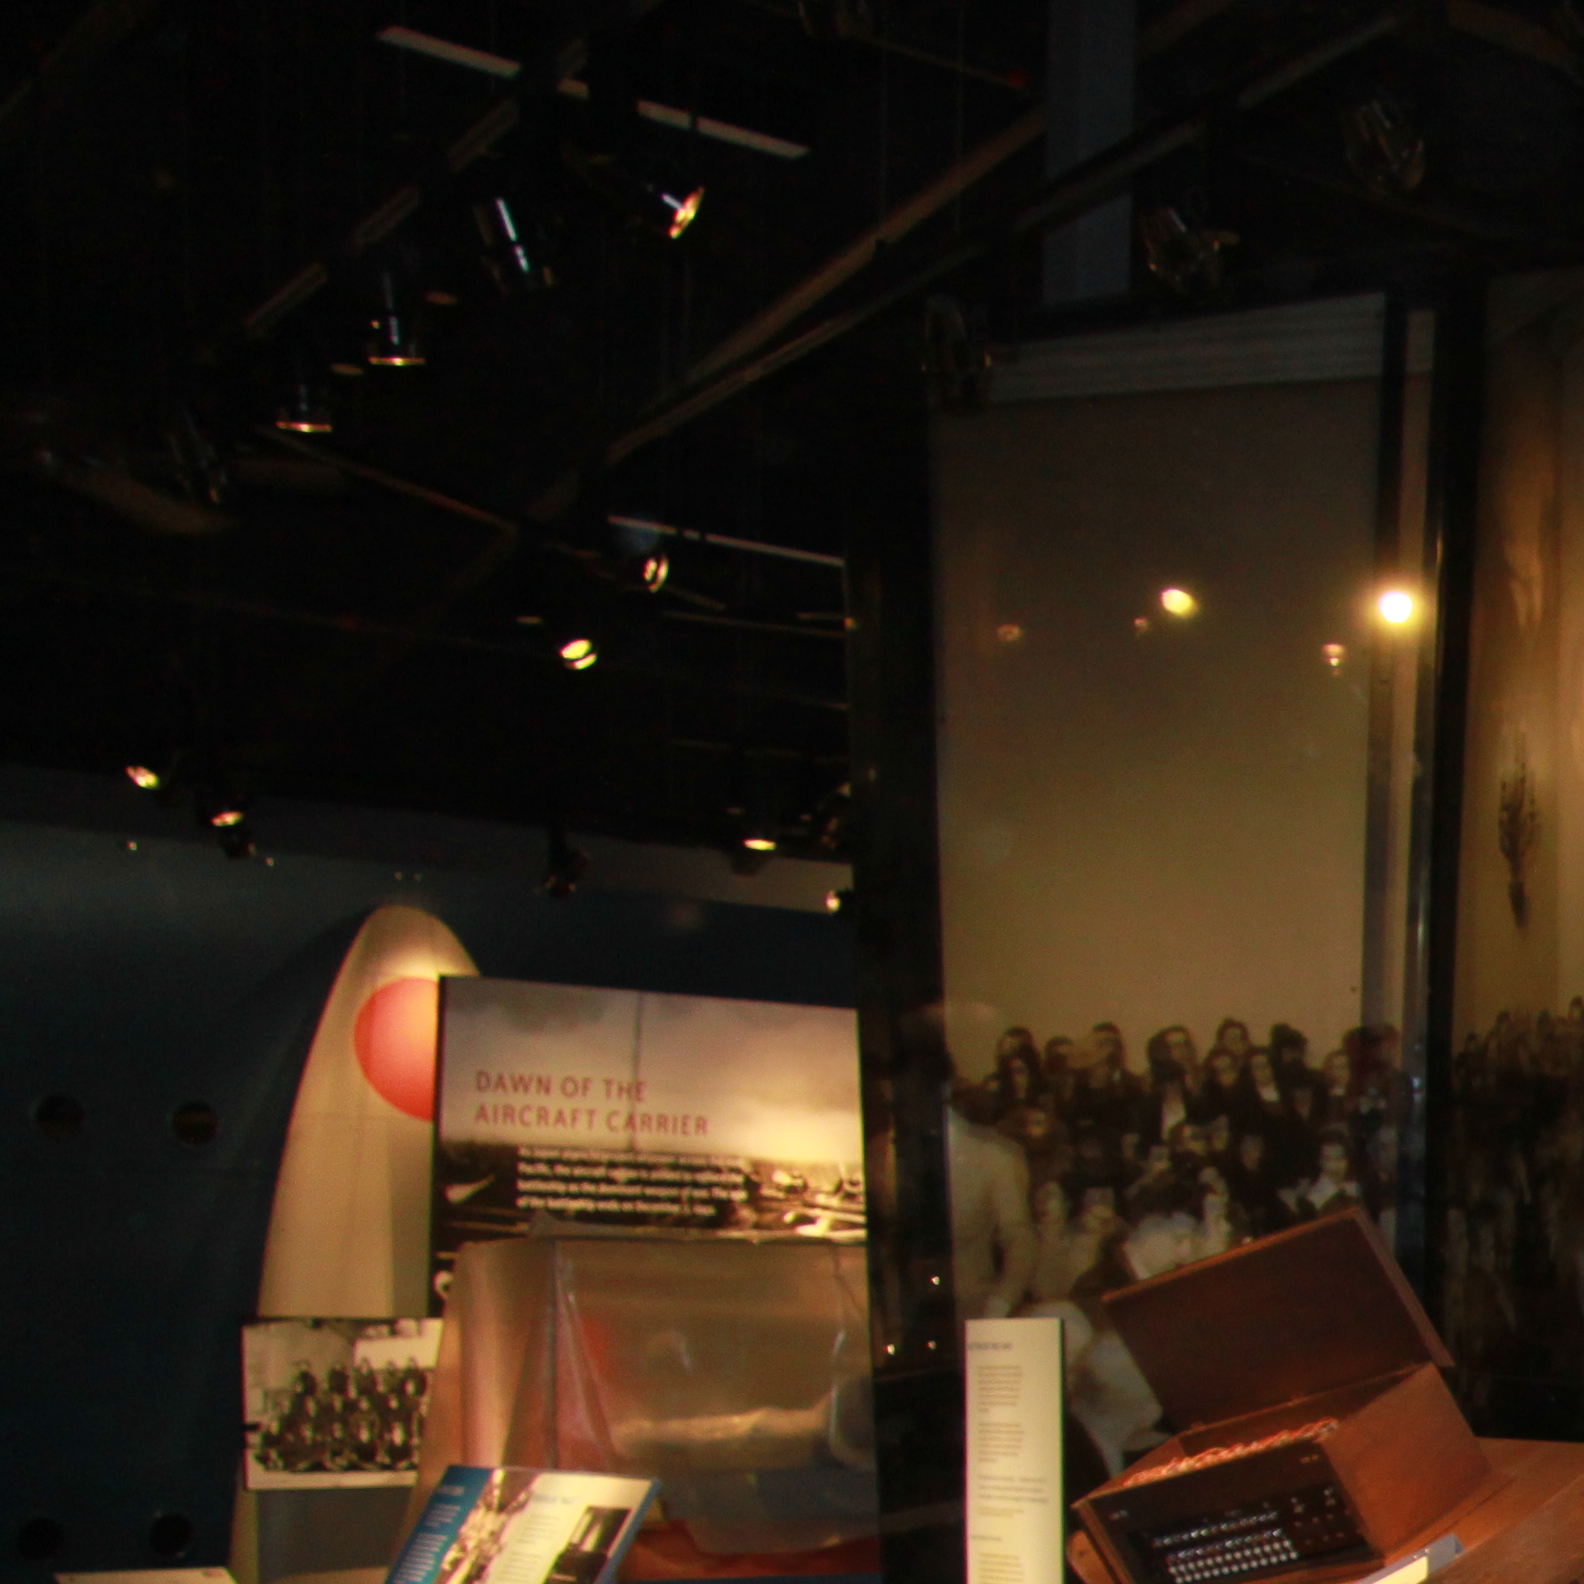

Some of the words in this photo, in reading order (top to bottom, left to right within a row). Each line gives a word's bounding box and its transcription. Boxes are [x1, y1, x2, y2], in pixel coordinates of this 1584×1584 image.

[475, 1070, 553, 1096] DAWN
[561, 1076, 593, 1098] OF
[605, 1079, 648, 1102] THE
[474, 1103, 598, 1131] AIRCRAFT
[606, 1110, 710, 1137] CARRIER
